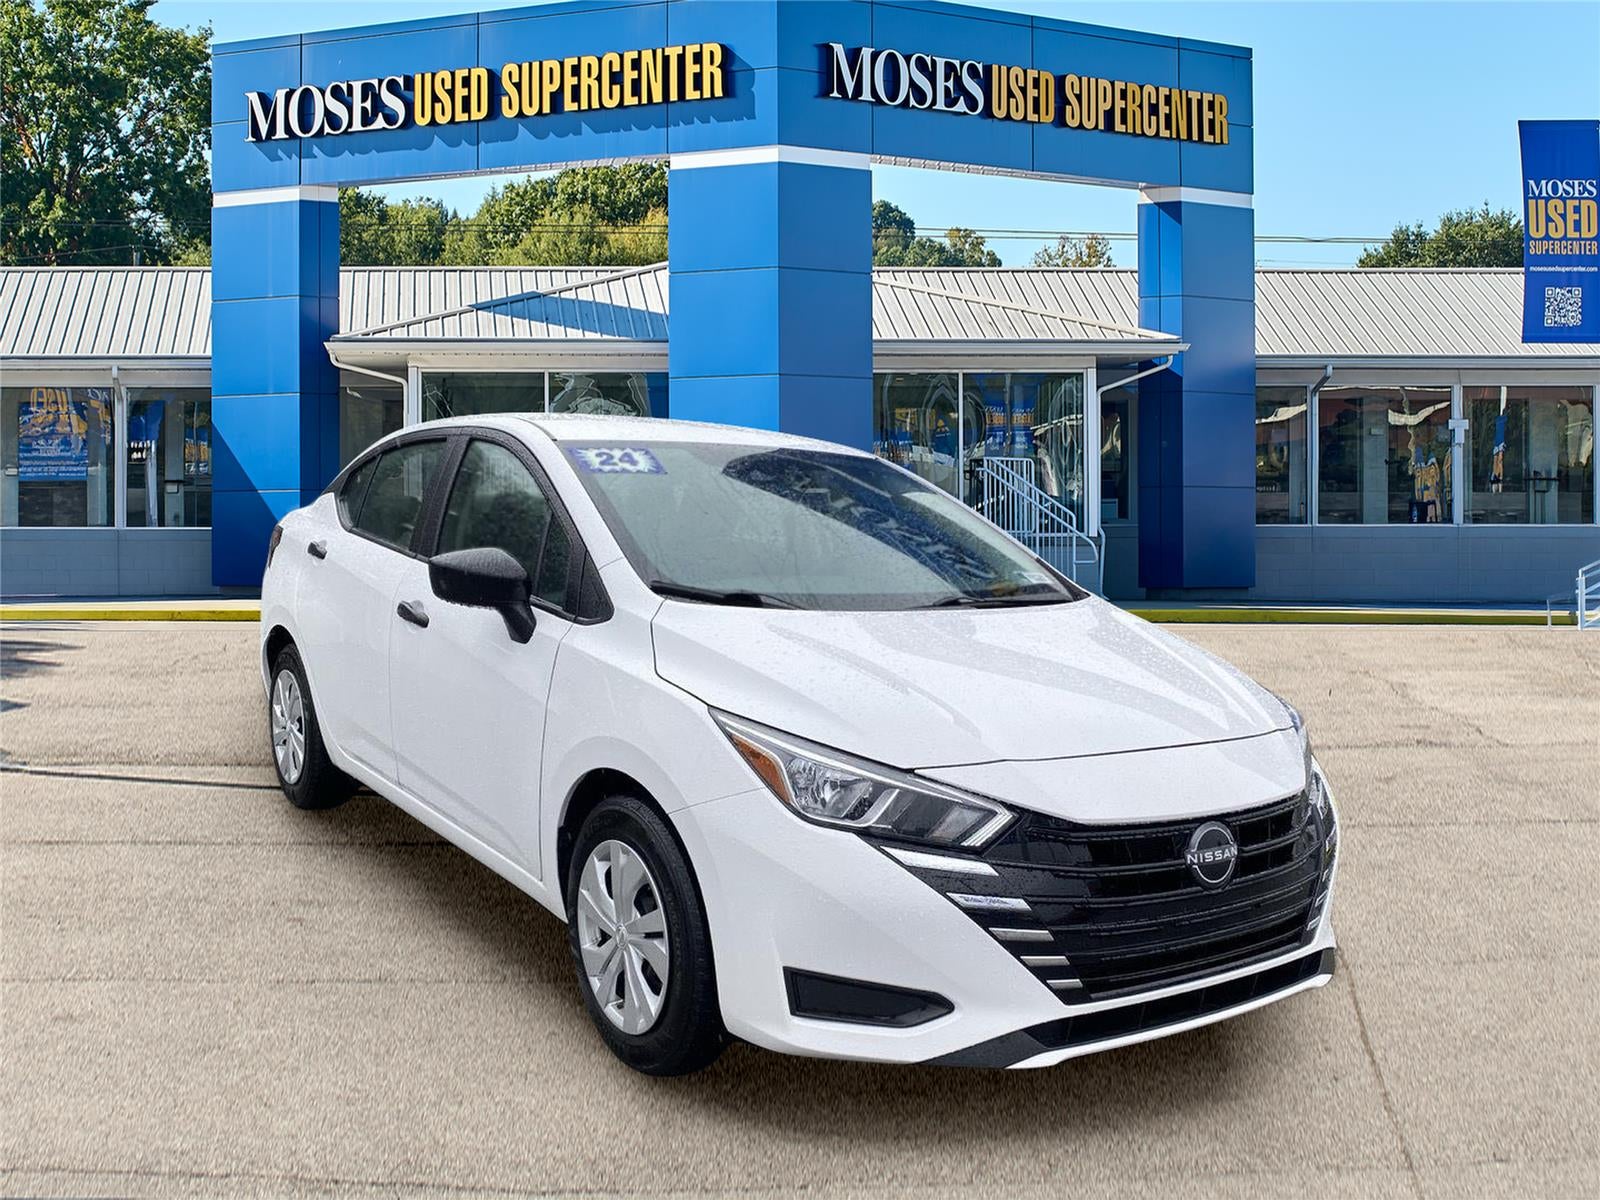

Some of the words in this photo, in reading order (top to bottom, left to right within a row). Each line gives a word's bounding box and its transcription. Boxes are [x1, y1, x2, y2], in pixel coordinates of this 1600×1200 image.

[245, 75, 406, 142] MOSES
[412, 67, 489, 126] USED
[500, 42, 724, 118] SUPERCENTER
[829, 42, 984, 116] MOSES
[991, 64, 1056, 123] USED
[1064, 74, 1229, 144] SUPERCENTER
[1527, 179, 1597, 198] MOSES
[1528, 199, 1598, 239] USED
[1529, 240, 1598, 255] SUPERCENTER
[595, 450, 640, 468] 24
[1187, 846, 1238, 864] NISSAN
